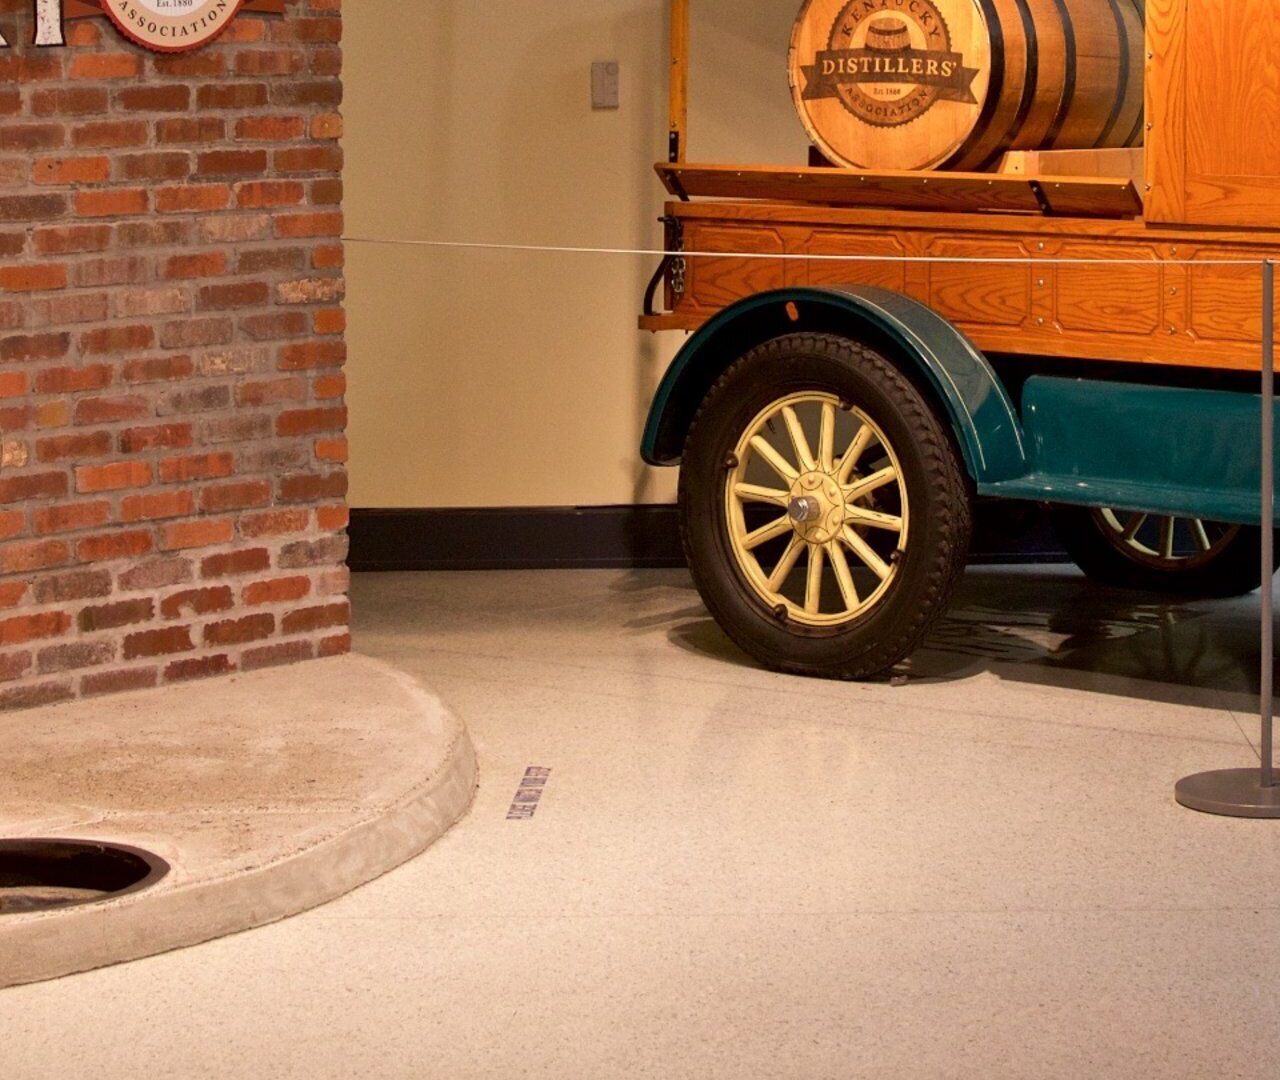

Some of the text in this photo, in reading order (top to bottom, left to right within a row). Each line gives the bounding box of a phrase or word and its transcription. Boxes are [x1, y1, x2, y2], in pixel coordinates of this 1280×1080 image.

[118, 0, 227, 37] ASSOCIATION
[822, 57, 957, 76] DISTILLERS'
[845, 87, 928, 118] ASSOCIATION
